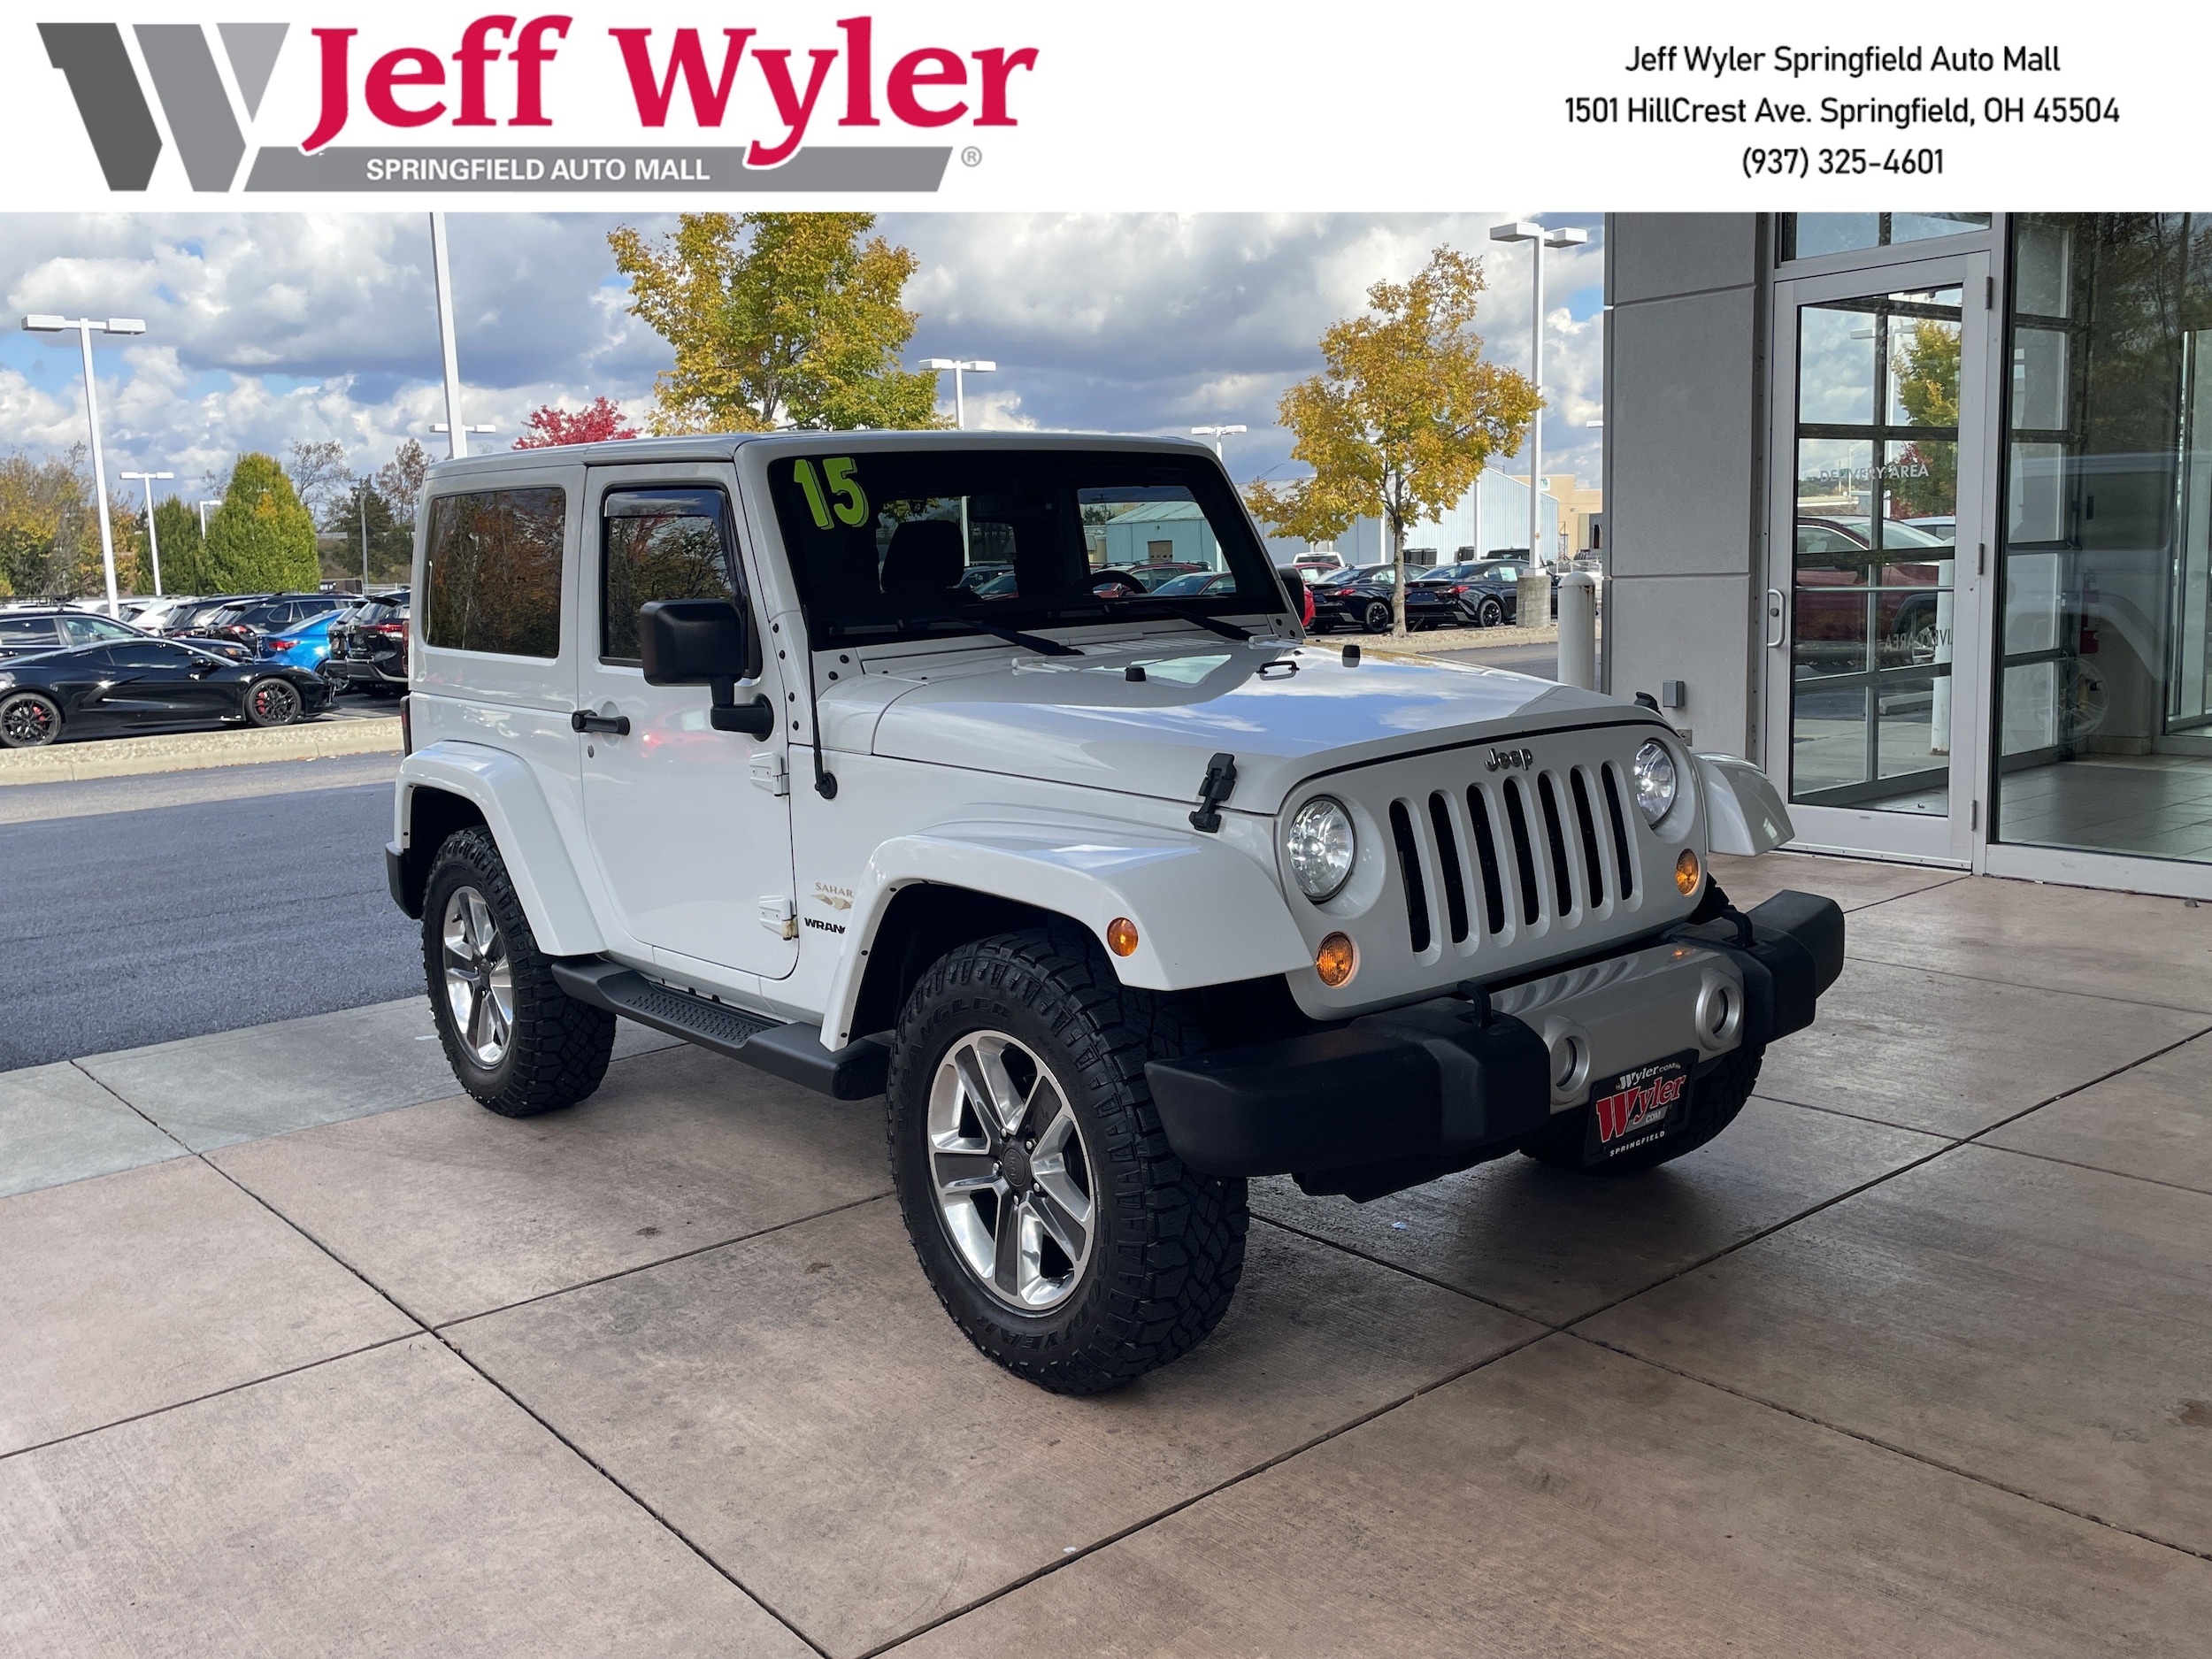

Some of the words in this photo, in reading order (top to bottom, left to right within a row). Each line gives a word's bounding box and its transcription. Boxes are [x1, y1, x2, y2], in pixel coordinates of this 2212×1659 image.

[1819, 466, 1886, 482] DELIVERY
[1888, 464, 1929, 480] AREA
[794, 457, 870, 530] 15
[1484, 748, 1533, 772] Jeep
[815, 881, 854, 898] SAHAR
[1596, 1074, 1687, 1143] Wyler
[1609, 1130, 1665, 1156] SPRINGFIELD
